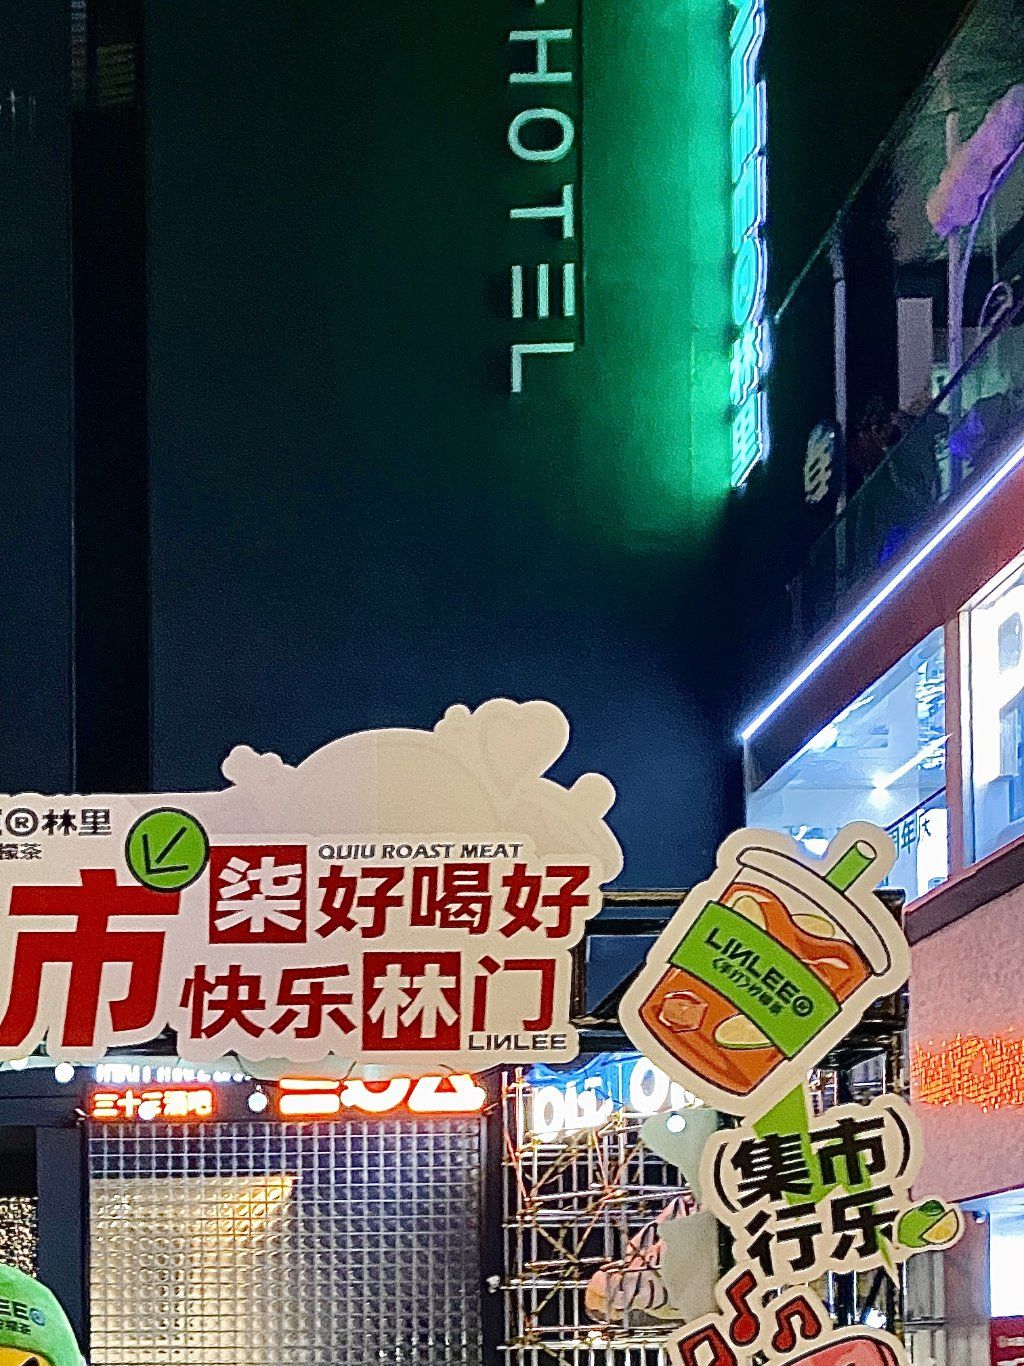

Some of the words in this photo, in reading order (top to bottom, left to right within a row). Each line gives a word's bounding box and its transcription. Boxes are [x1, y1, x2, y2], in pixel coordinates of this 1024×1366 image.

[209, 845, 590, 944] 柒好喝好
[381, 843, 455, 859] ROAST
[460, 843, 524, 859] MEAT
[179, 951, 556, 1051] 快乐林门
[745, 1184, 901, 1278] 行乐
